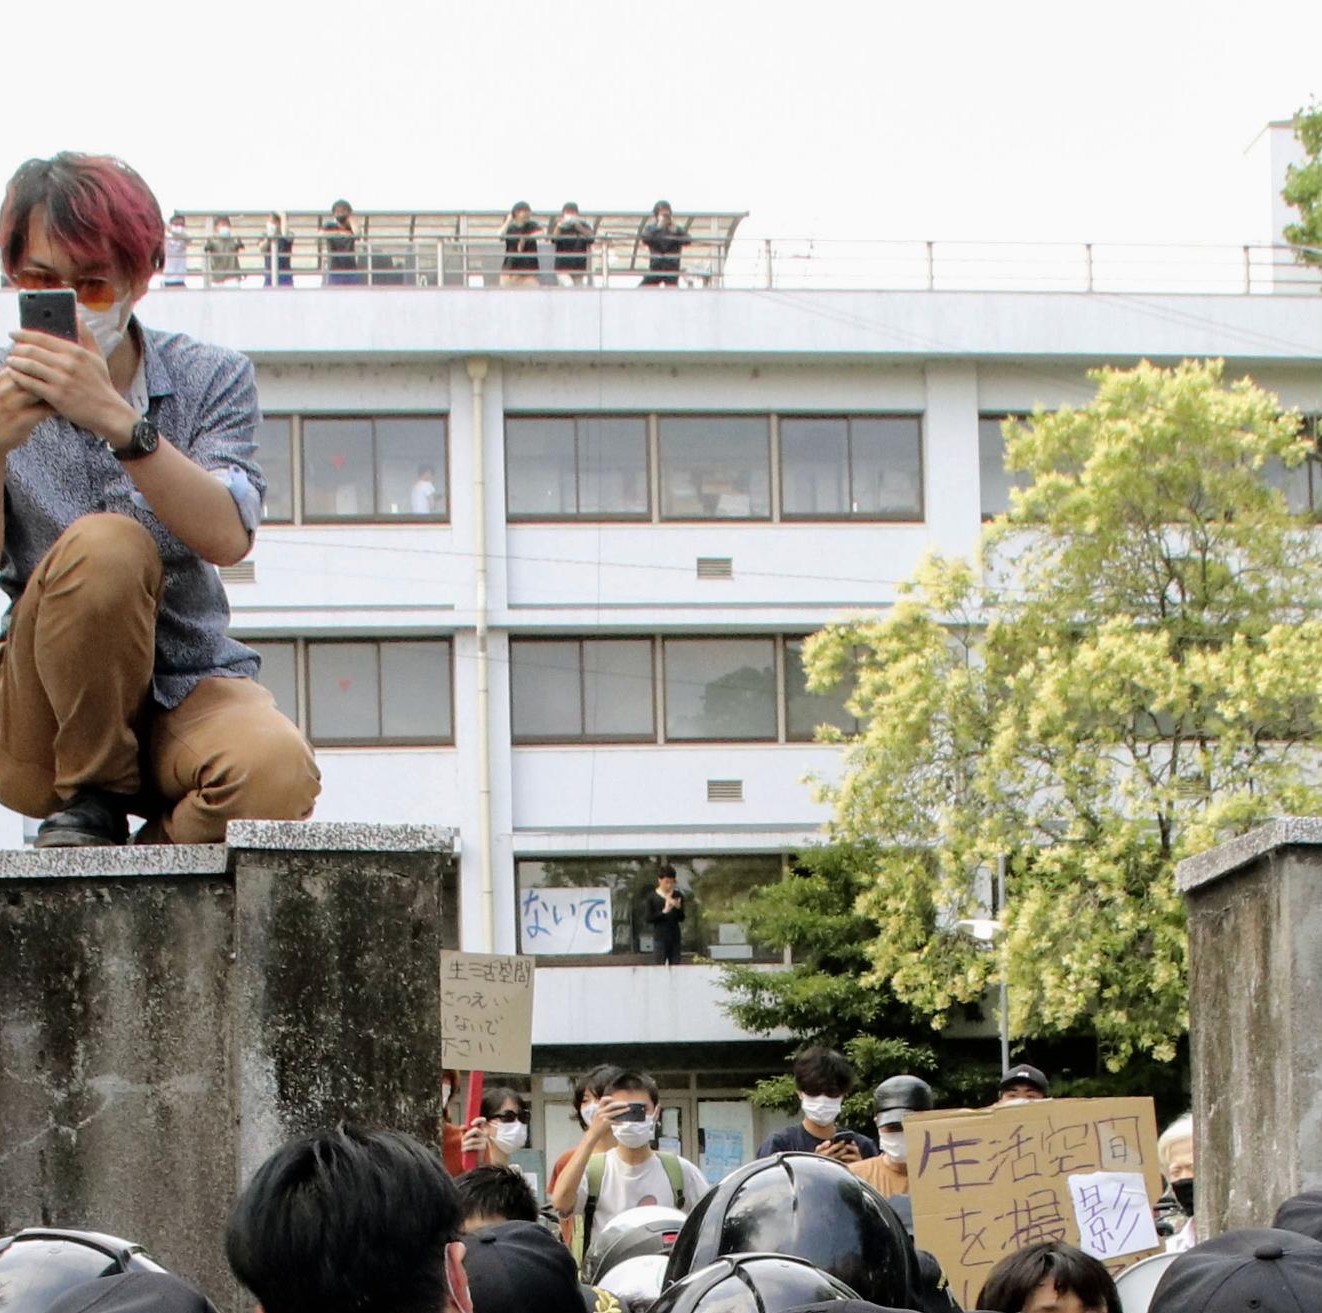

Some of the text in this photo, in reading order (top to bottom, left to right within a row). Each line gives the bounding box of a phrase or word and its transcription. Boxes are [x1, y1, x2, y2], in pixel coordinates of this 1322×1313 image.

[523, 890, 608, 939] ないで
[446, 957, 532, 989] 生活空間
[443, 991, 509, 1009] さつえい
[917, 1115, 1143, 1192] 生活空間
[944, 1183, 1141, 1268] を撮影
